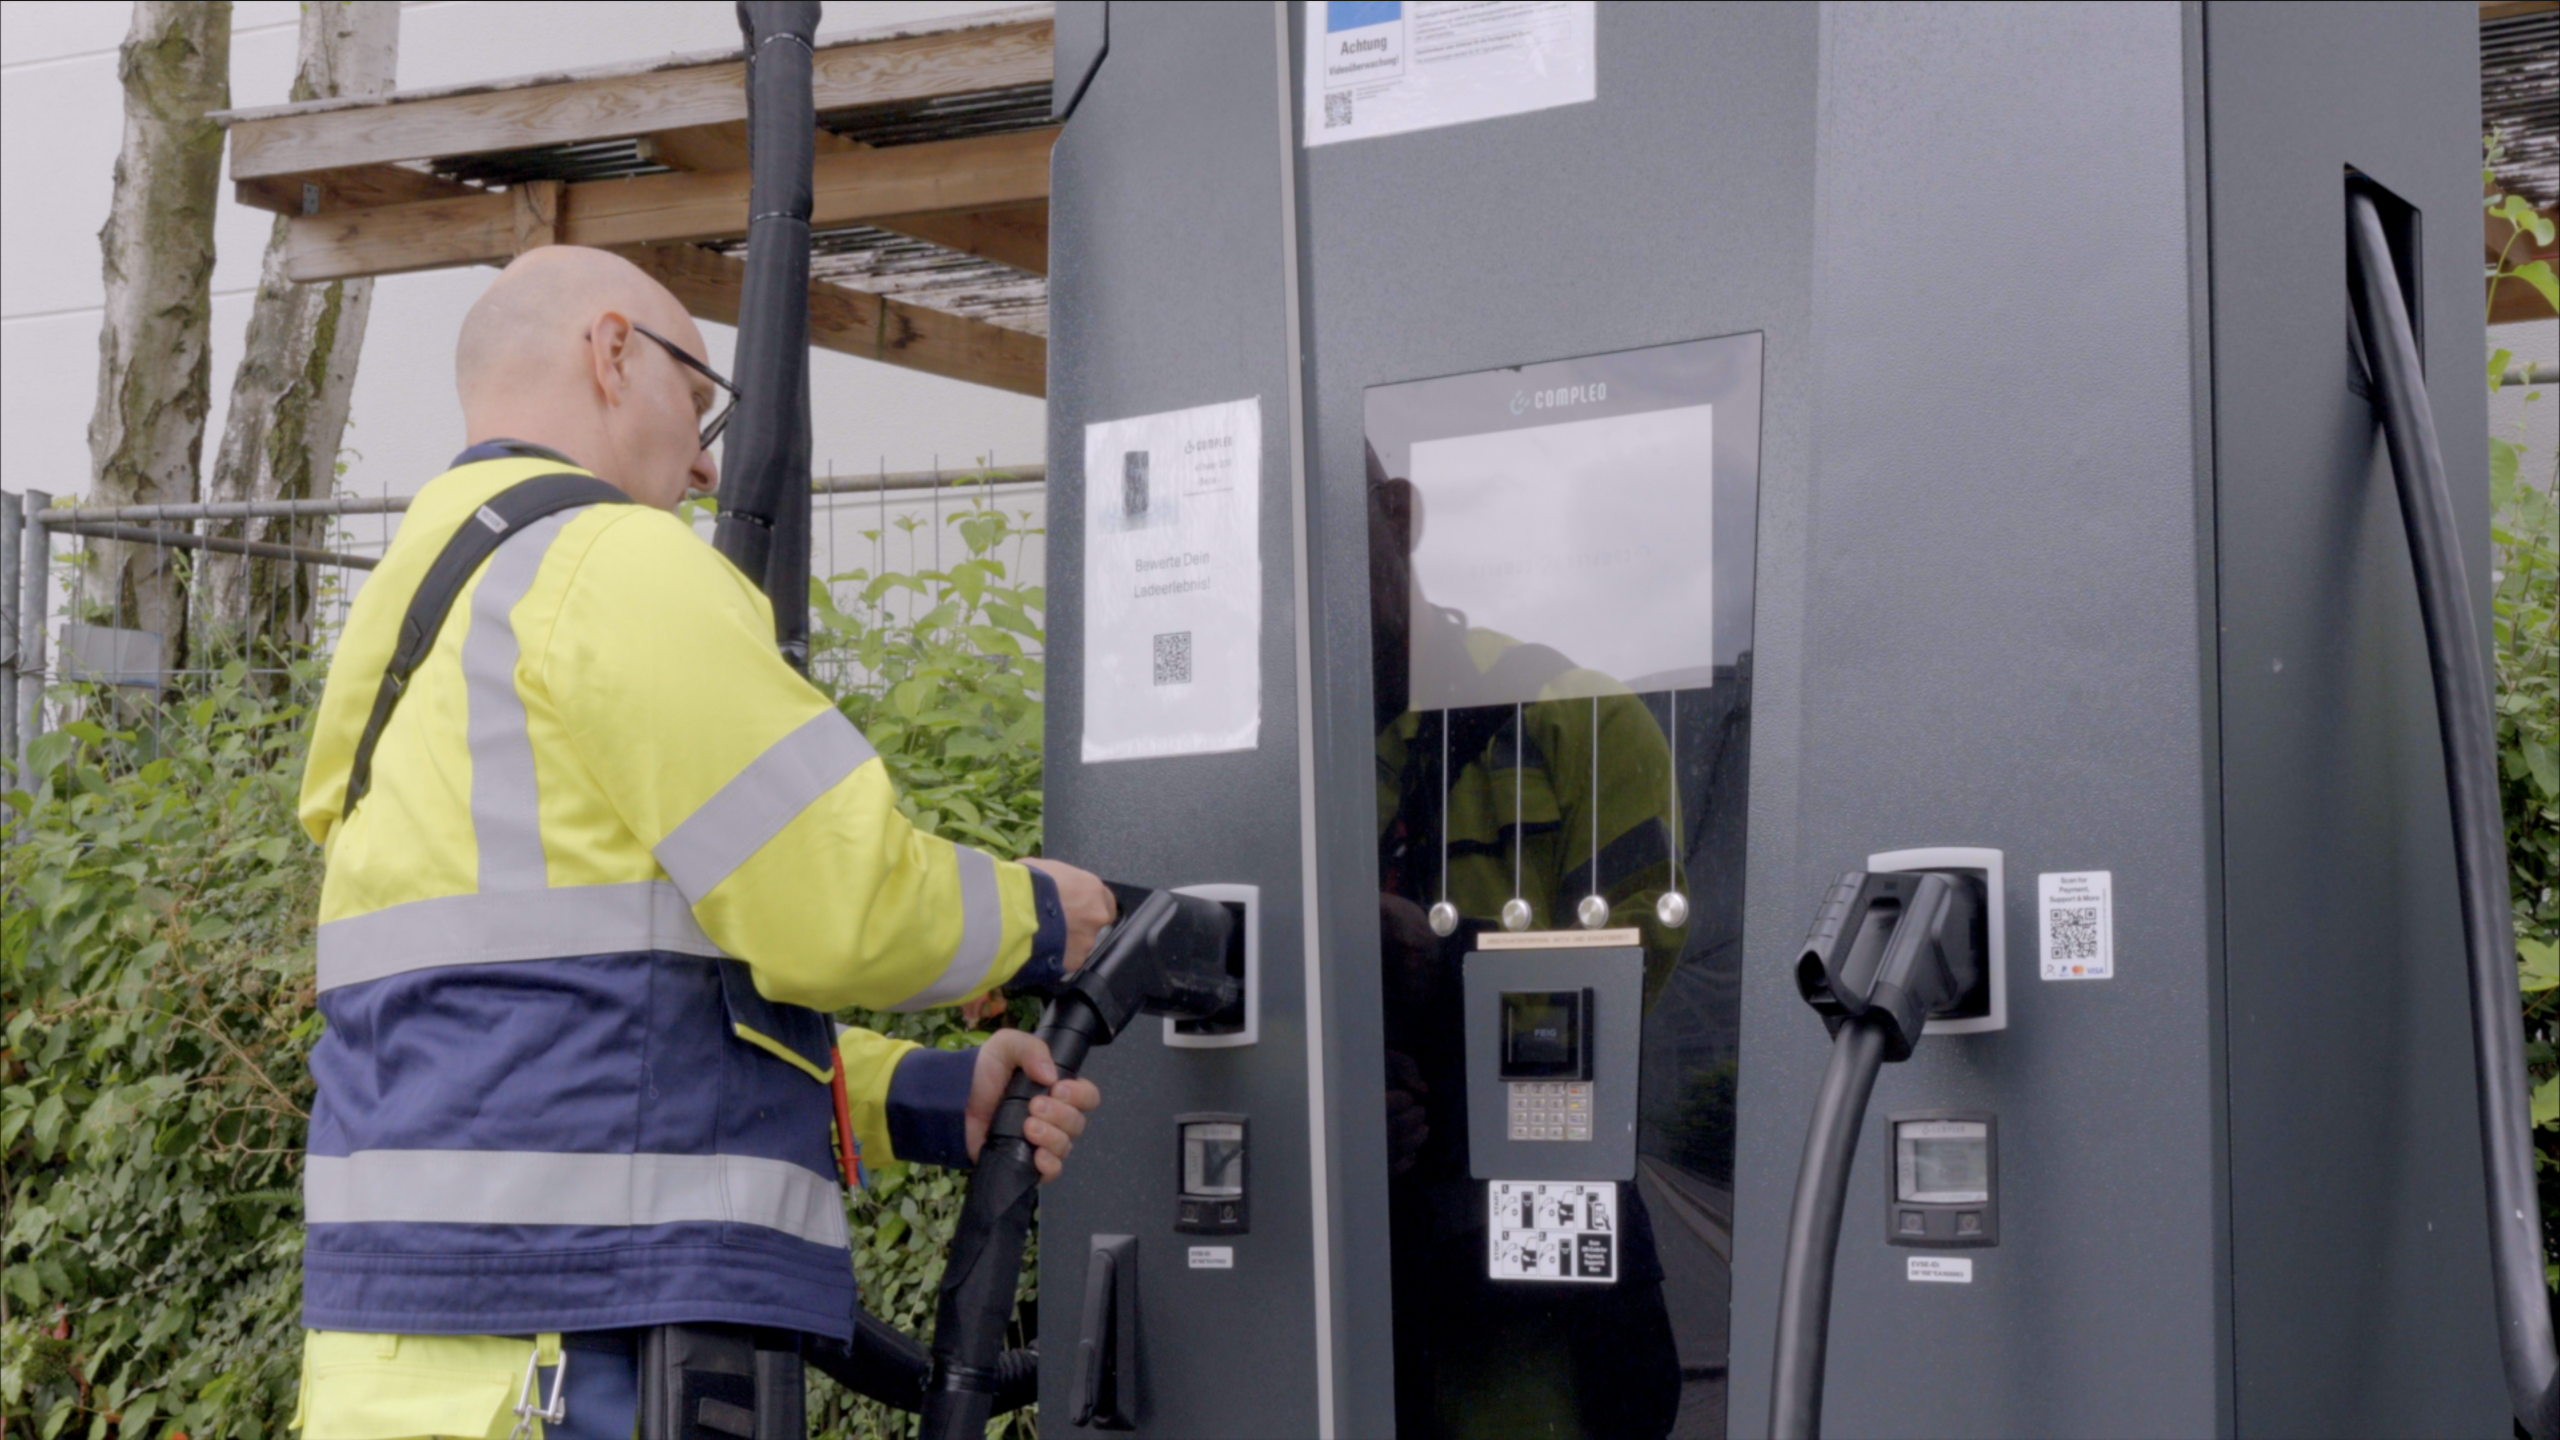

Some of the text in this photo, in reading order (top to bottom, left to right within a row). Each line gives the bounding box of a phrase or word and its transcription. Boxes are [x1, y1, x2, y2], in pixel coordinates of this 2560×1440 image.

[1340, 37, 1387, 56] Achtung
[1534, 382, 1607, 409] COMPLEO
[1135, 550, 1210, 573] Bewerte Dein
[1134, 575, 1211, 598] Ladeerlebnis!
[2060, 876, 2087, 884] Scan for
[2058, 886, 2090, 894] Payment,
[2049, 895, 2076, 904] Support
[2083, 895, 2100, 903] More
[1534, 1028, 1557, 1037] FEIG
